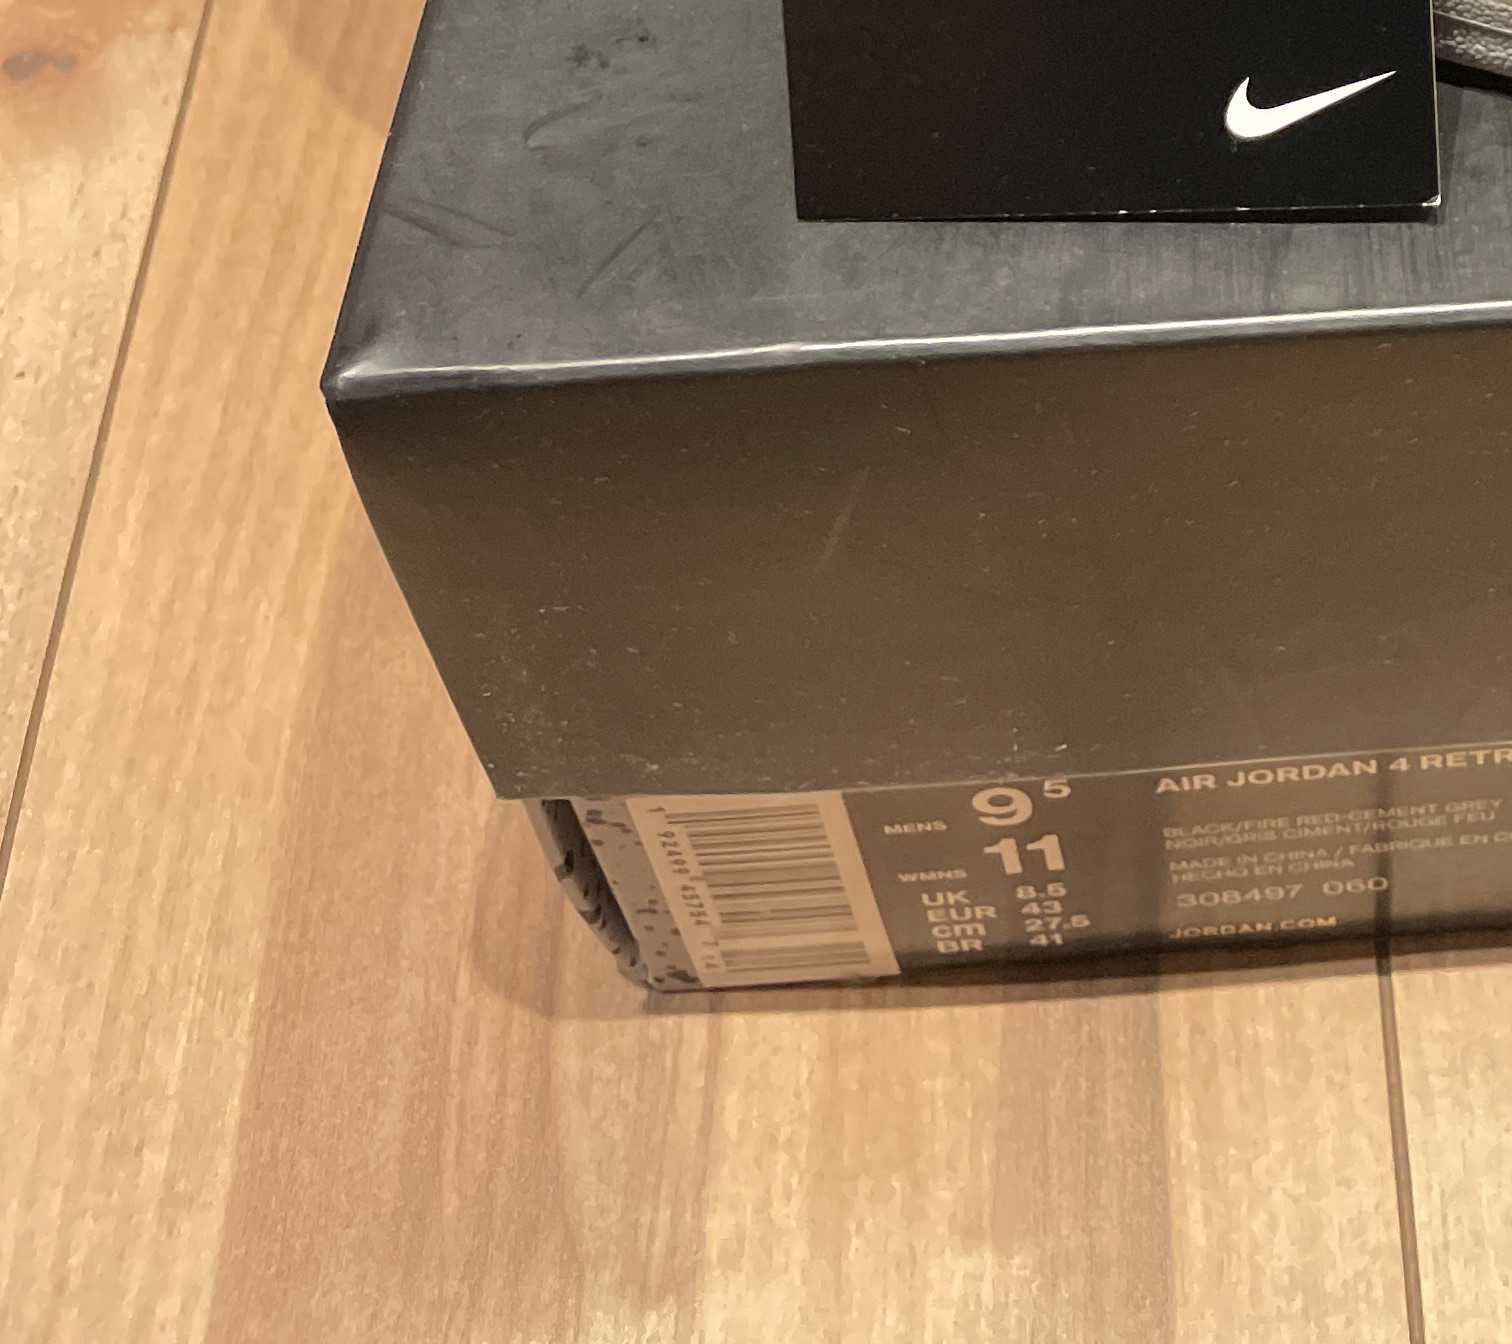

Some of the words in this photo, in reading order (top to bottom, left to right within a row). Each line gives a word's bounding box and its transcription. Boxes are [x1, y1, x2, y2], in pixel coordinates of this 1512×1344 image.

[1154, 772, 1217, 795] AIR
[1226, 757, 1379, 790] JORDAN
[1387, 755, 1412, 774] 4
[882, 819, 948, 836] MENS
[897, 867, 969, 883] WMNS
[983, 833, 1066, 877] 11
[920, 889, 973, 908] UK
[1014, 881, 1068, 901] 8.5
[926, 904, 999, 924] EUR
[1020, 899, 1064, 916] 43
[930, 922, 987, 939] cm
[1023, 913, 1092, 934] 27.5
[935, 938, 985, 954] BR
[1028, 932, 1065, 947] 41
